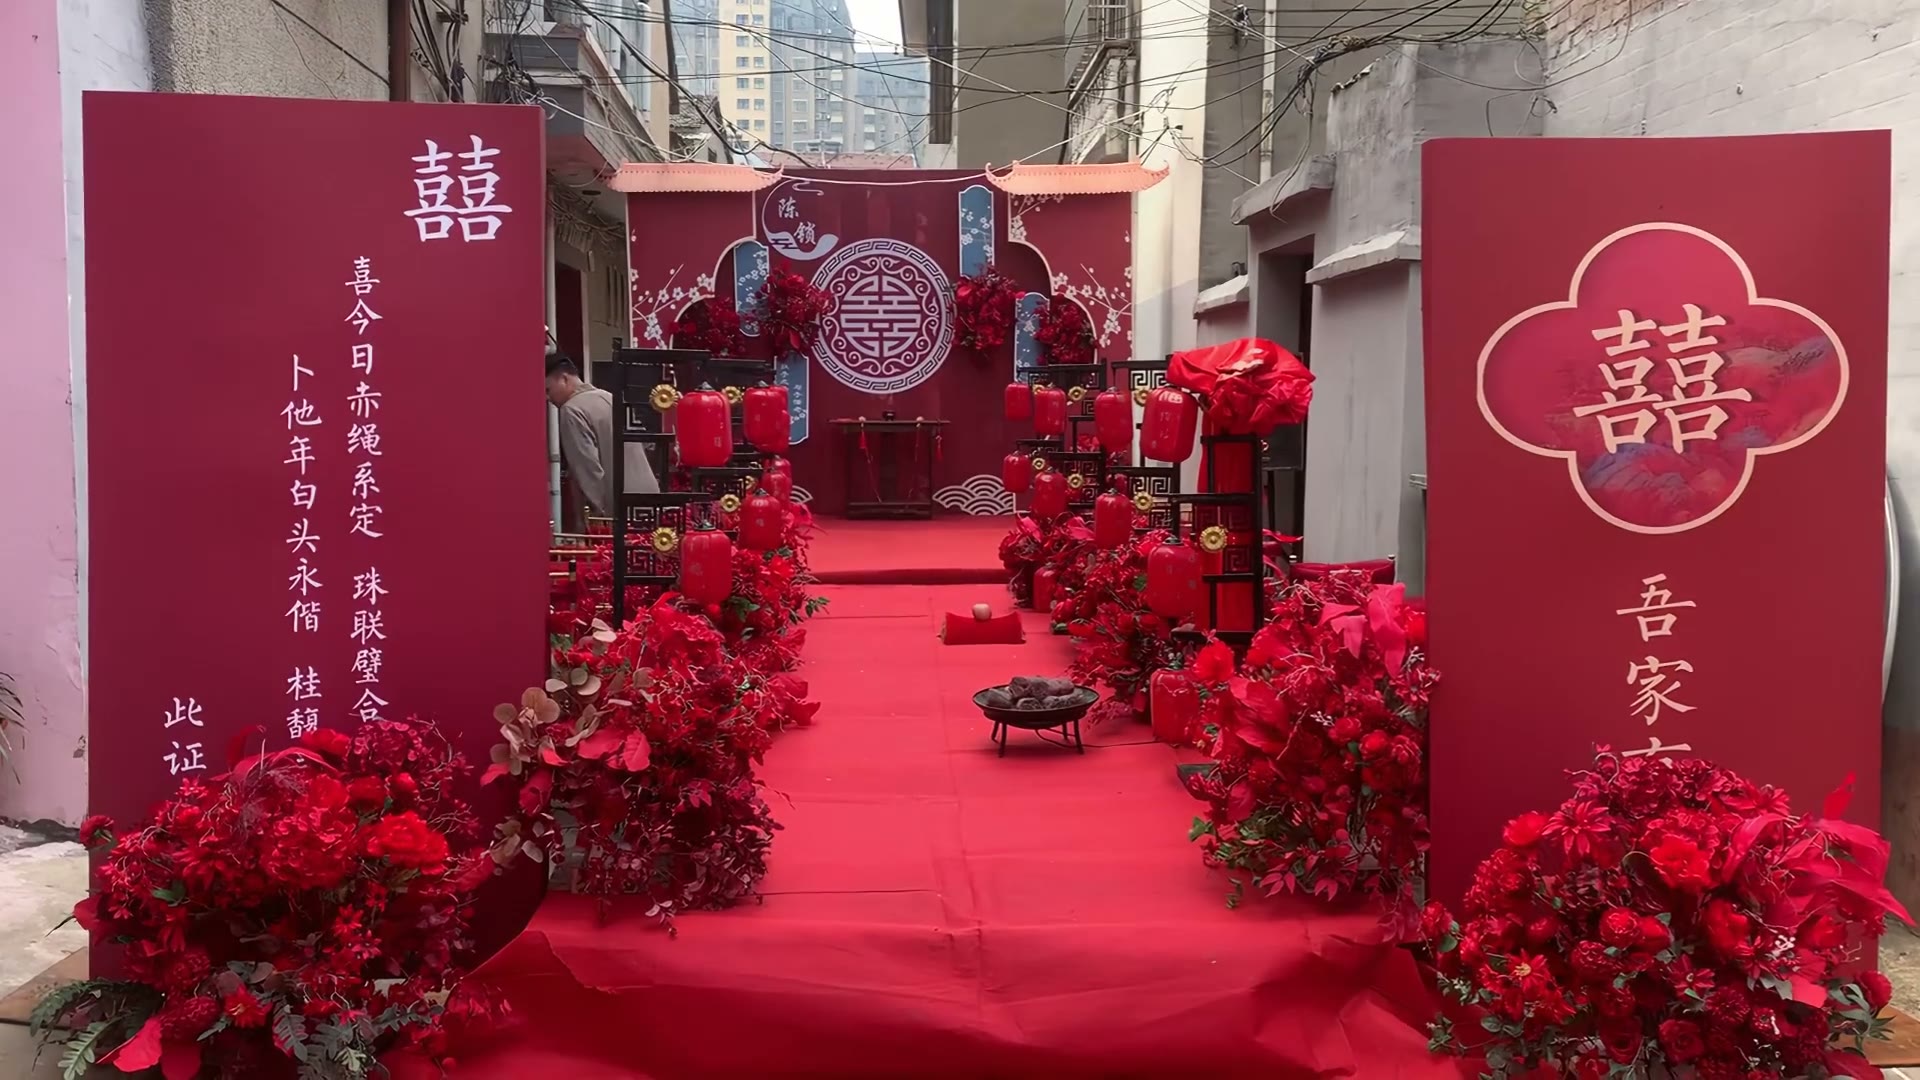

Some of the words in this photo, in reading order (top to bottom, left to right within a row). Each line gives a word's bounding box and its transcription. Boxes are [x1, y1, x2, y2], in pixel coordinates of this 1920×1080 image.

[404, 134, 512, 243] 囍
[345, 256, 384, 538] 喜今日赤绳系定
[1573, 303, 1752, 454] 囍
[280, 354, 323, 633] 卜他年白头永偕
[286, 665, 322, 765] 桂馥
[351, 566, 389, 722] 珠联璧合
[163, 697, 207, 776] 此证
